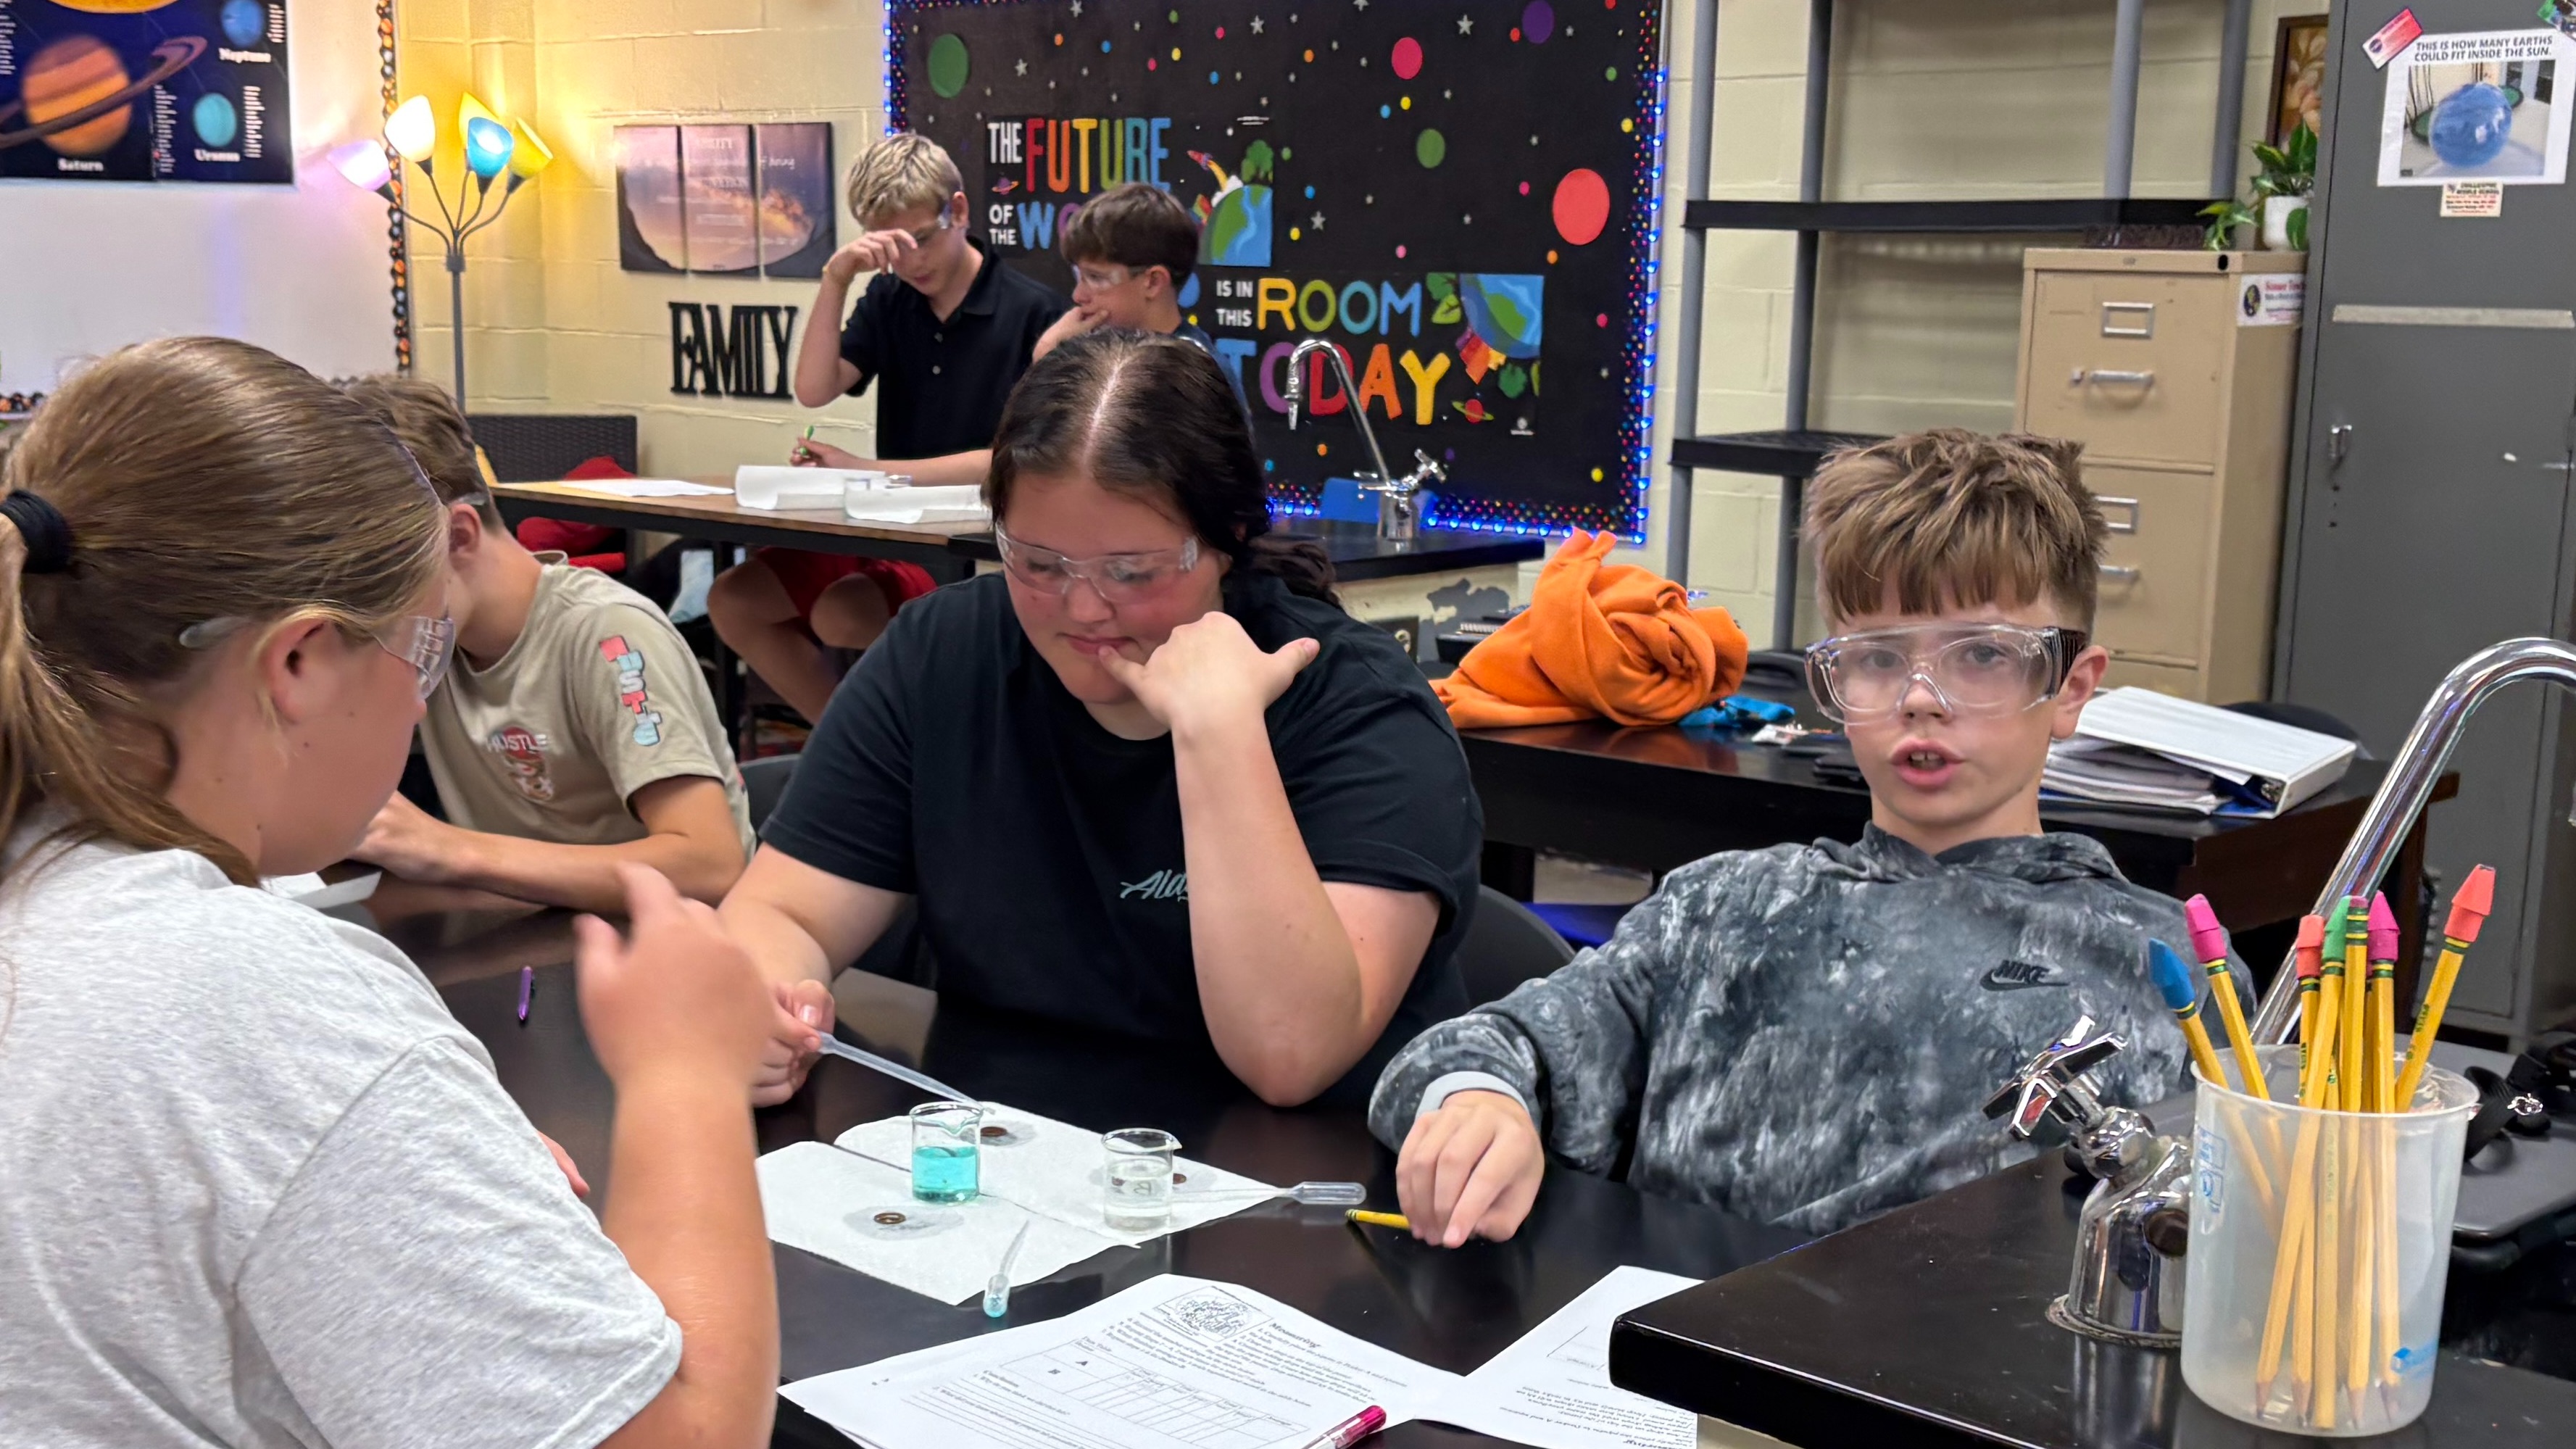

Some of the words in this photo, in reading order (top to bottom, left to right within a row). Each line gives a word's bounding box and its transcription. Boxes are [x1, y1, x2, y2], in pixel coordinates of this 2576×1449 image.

[2416, 41, 2438, 51] THIS
[2440, 41, 2450, 51] IS
[2451, 39, 2477, 50] HOW
[2479, 37, 2511, 49] MANY
[2513, 35, 2553, 47] EARTHS
[2414, 51, 2448, 62] COULD
[2451, 50, 2466, 60] FIT
[2468, 49, 2501, 59] INSIDE
[2505, 47, 2525, 57] THE
[57, 157, 104, 172] Saturn
[987, 121, 1023, 164] THE
[1026, 117, 1172, 194] FUTURE
[989, 204, 1014, 225] OF
[989, 228, 1017, 246] THE
[1216, 280, 1232, 297] IS
[1236, 281, 1253, 298] IN
[1257, 277, 1422, 338] ROOM
[1216, 308, 1252, 328] THIS
[668, 302, 798, 400] FAMILY
[1214, 338, 1450, 425] TODAY
[486, 734, 549, 754] HUSTLE
[1993, 959, 2051, 984] NIKE
